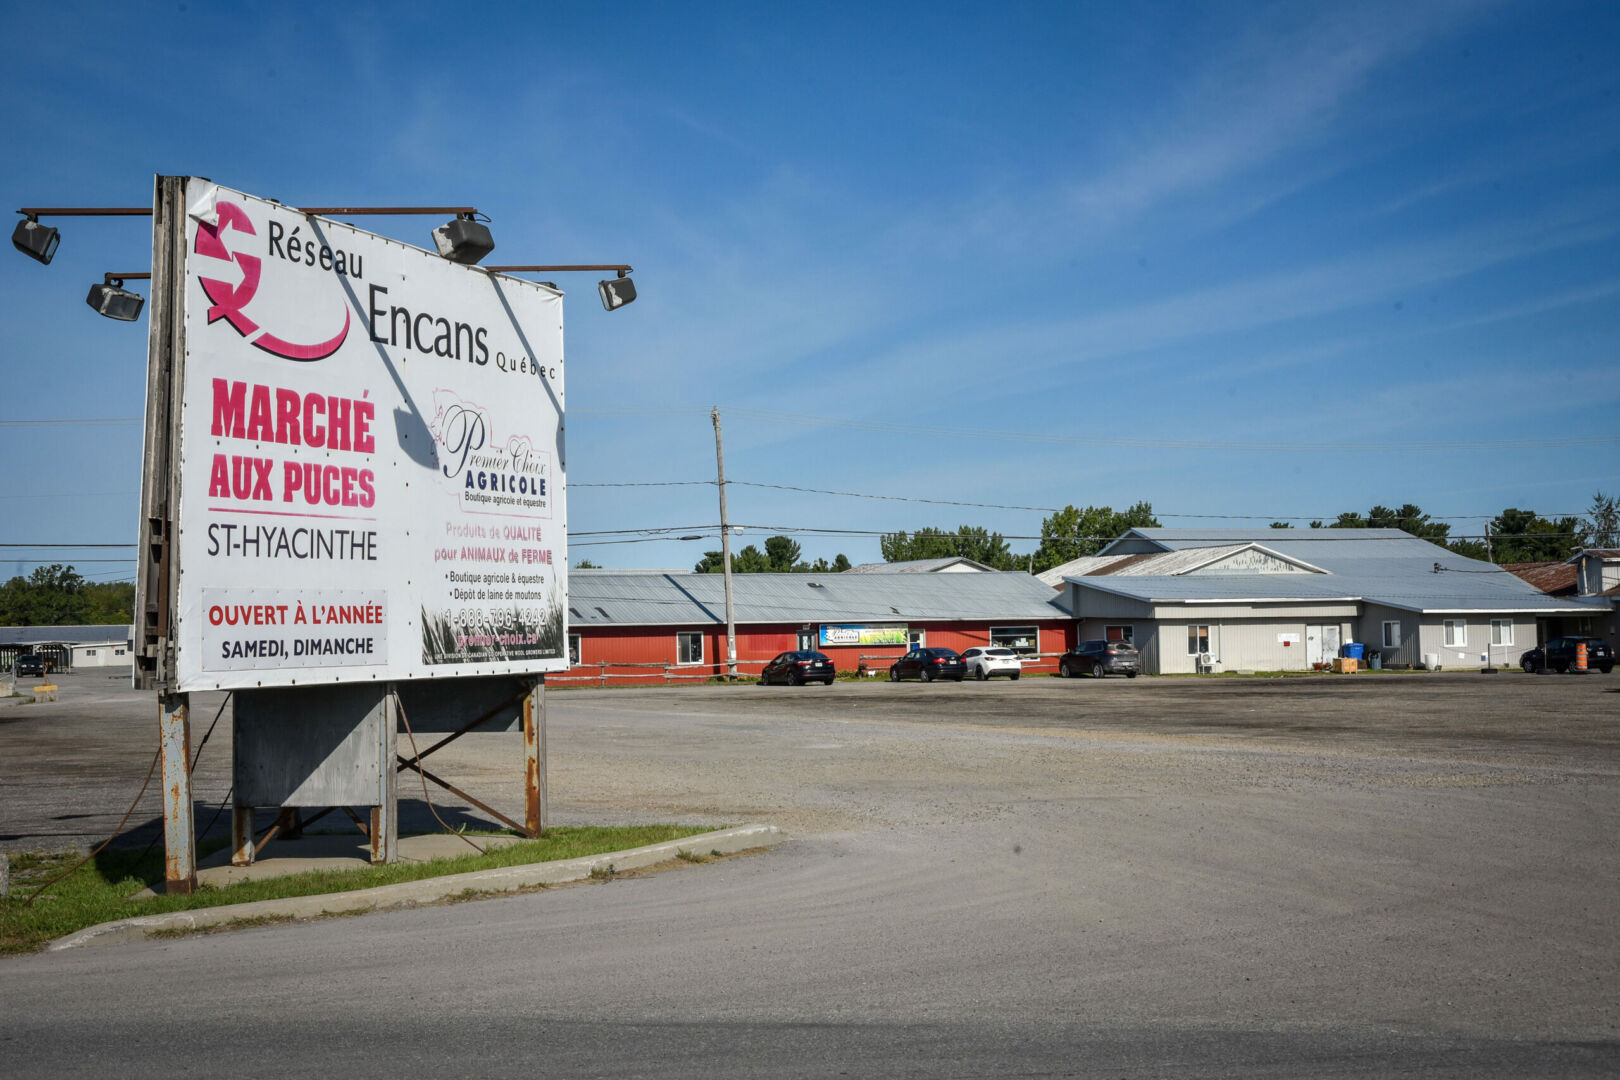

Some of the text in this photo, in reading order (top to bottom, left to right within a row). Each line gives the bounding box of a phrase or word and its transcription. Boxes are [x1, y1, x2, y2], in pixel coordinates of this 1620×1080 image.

[268, 220, 362, 279] Réseau
[369, 284, 489, 366] Encans
[496, 351, 556, 380] Québec
[211, 378, 375, 454] MARCHÉ
[442, 405, 546, 478] Premier Choix
[209, 454, 376, 508] AUX PUCES
[465, 470, 546, 496] AGRICOLE
[465, 491, 492, 504] Boutique
[493, 496, 515, 506] agricole
[208, 523, 376, 560] ST-HYACINTHE
[446, 521, 542, 542] Produits de QUALITÉ
[434, 546, 552, 564] pour ANIMAUX de FERME
[450, 571, 544, 585] Boutique agricole & équestre
[454, 589, 542, 601] Dépôt de laine de moutons
[209, 600, 383, 626] OUVERT À L'ANNÉE
[445, 608, 546, 628] 1-888-796-4242
[222, 638, 374, 659] SAMEDI, DIMANCHE
[457, 631, 536, 648] premier-choix.ca
